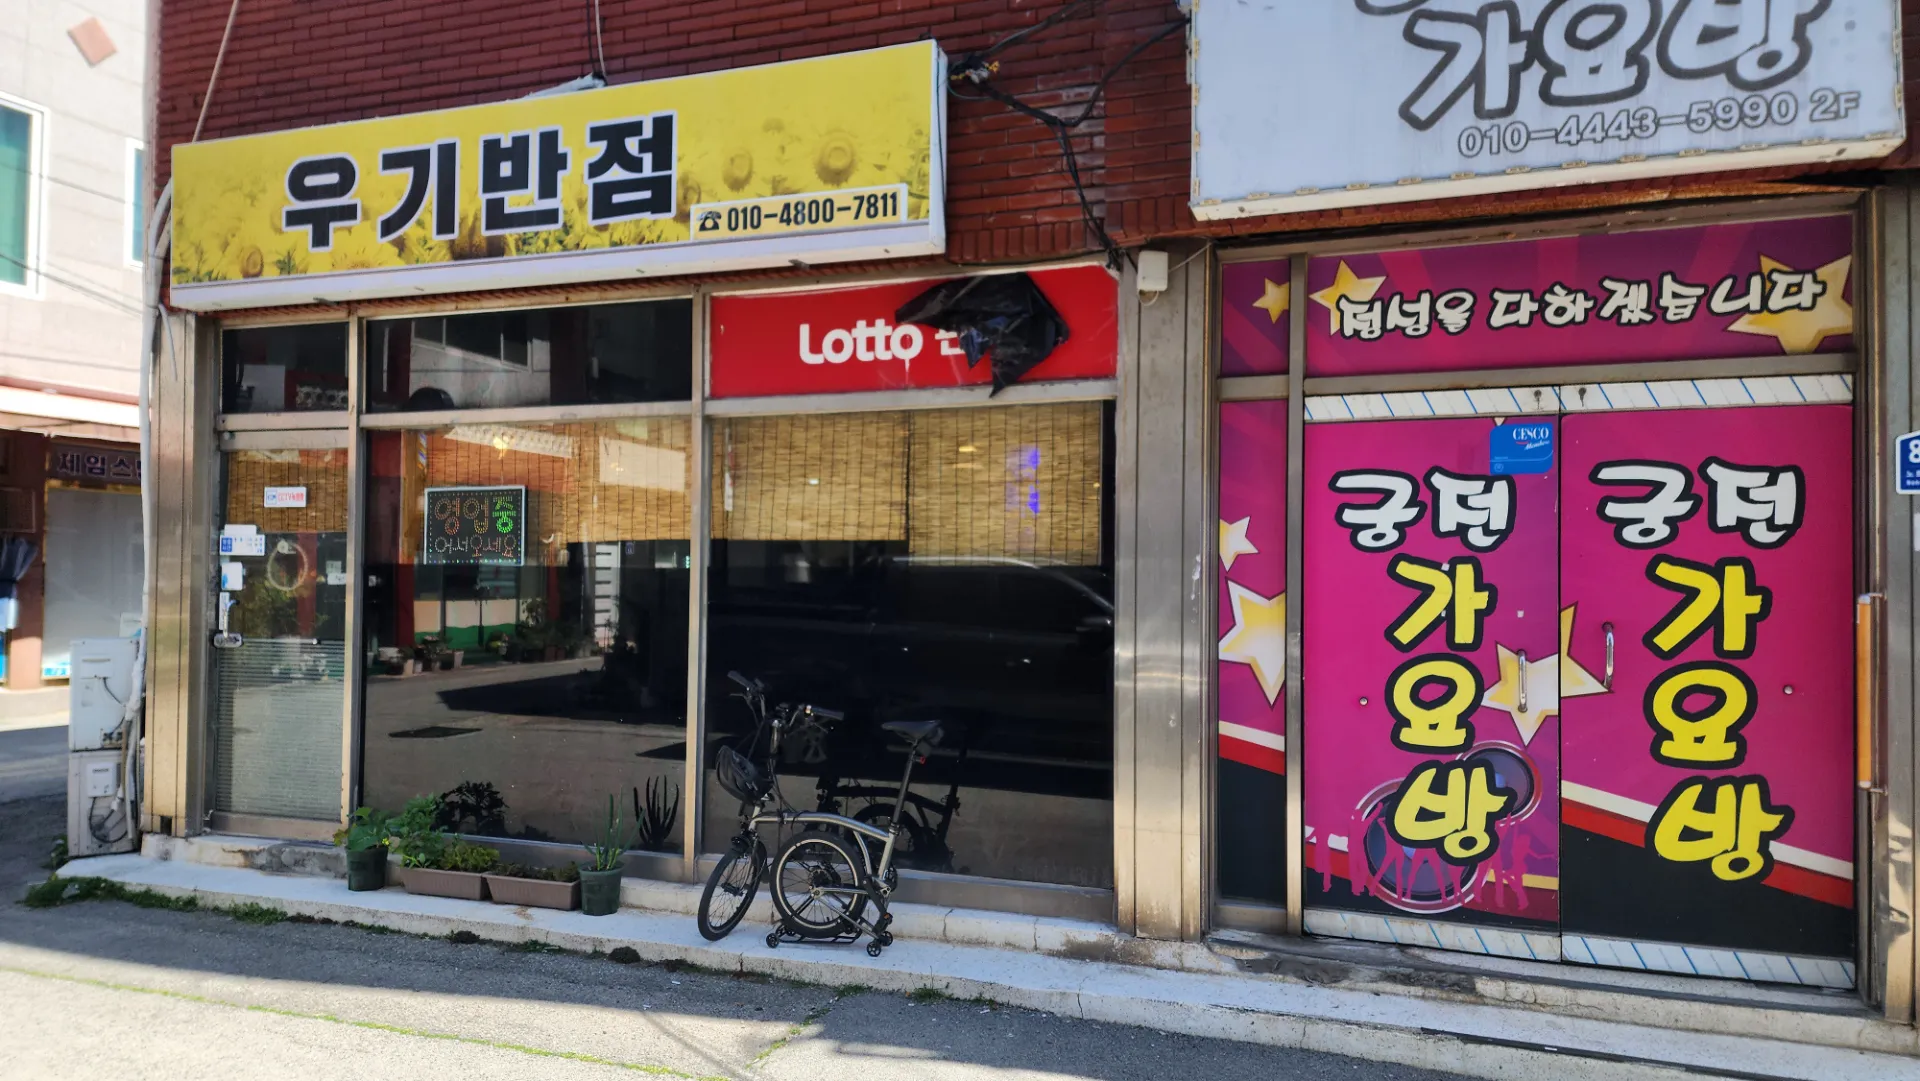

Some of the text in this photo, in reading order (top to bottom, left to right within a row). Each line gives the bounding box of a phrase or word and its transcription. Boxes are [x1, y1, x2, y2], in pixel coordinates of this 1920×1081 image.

[1399, 0, 1832, 131] 가요방
[1457, 87, 1861, 158] 010-4443-5990 2F
[282, 110, 677, 252] 우기반점
[727, 192, 898, 231] 010-4800-7811
[1338, 268, 1826, 339] 정성을 다하겠습니다
[799, 319, 923, 364] Lotto
[1512, 427, 1549, 440] CESCO
[434, 496, 517, 535] 영업중
[1329, 466, 1516, 553] 궁전
[1589, 456, 1806, 550] 궁전
[434, 534, 517, 558] 어서오세요
[1384, 553, 1517, 866] 가요방
[1642, 554, 1794, 886] 가요방
